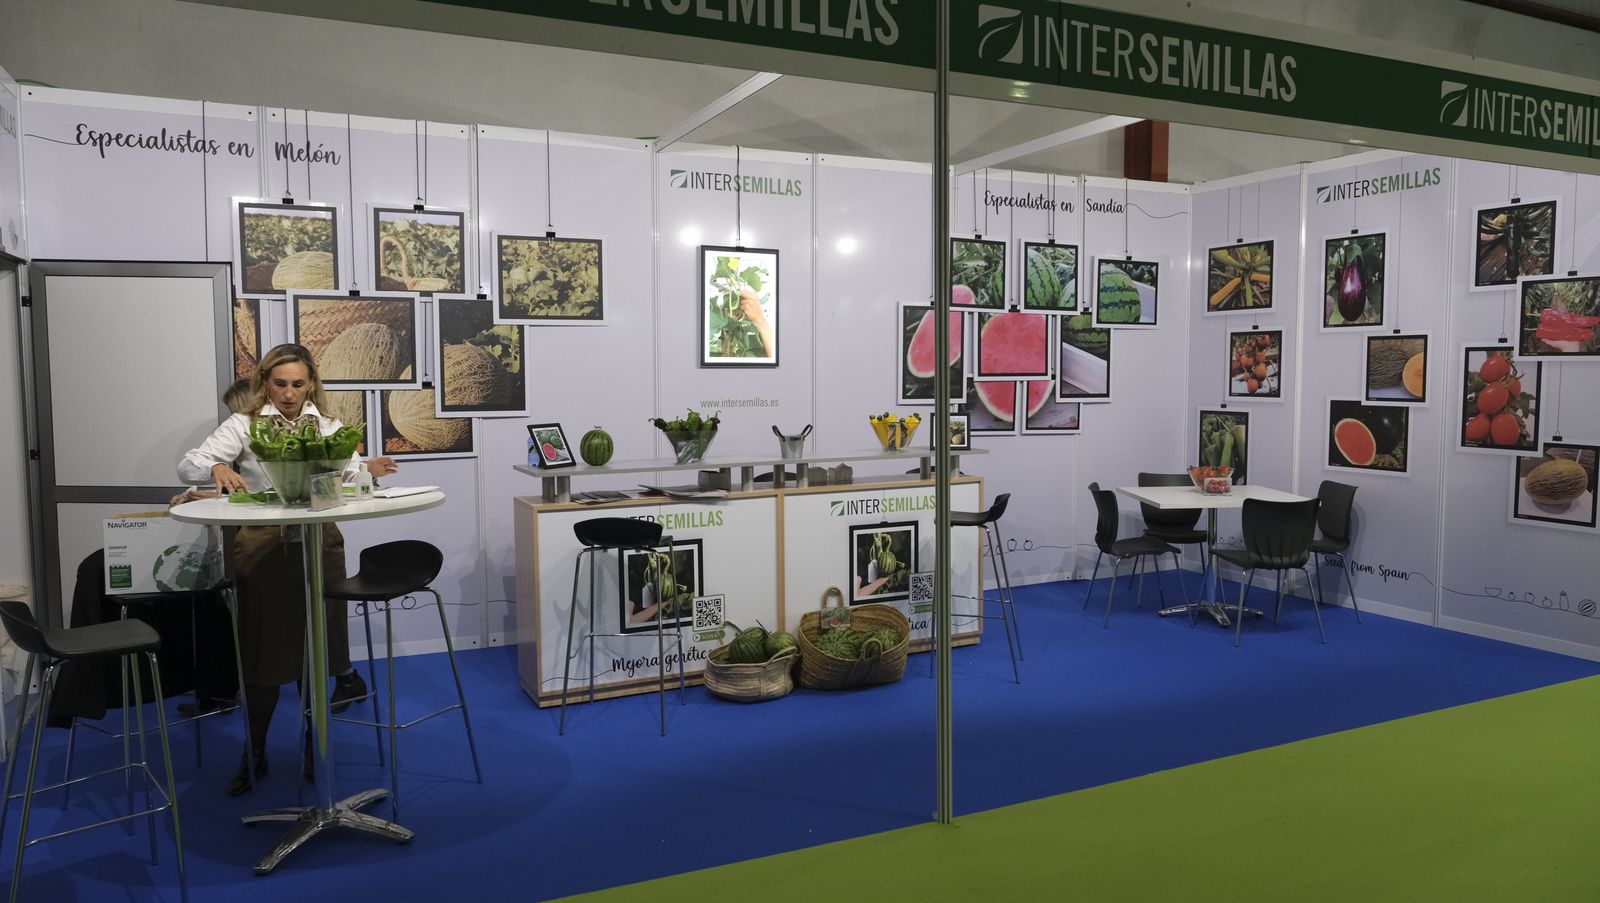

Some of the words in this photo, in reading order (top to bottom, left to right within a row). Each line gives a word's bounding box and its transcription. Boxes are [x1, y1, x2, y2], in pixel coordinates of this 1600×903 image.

[1033, 15, 1297, 102] INTERSEMILLAS
[75, 123, 221, 159] Especialistas
[228, 141, 254, 158] en
[274, 141, 341, 166] Melón
[690, 171, 802, 197] INTERSEMILLAS
[1333, 167, 1441, 201] INTERSEMILLAS
[984, 190, 1057, 215] Especialistas
[1060, 200, 1074, 213] en
[1086, 198, 1126, 214] Sandía
[700, 397, 780, 408] www.intersemillas.es
[1350, 559, 1375, 577] from
[1379, 564, 1409, 583] Spain
[612, 655, 660, 678] Mejora
[664, 646, 712, 673] genétic
